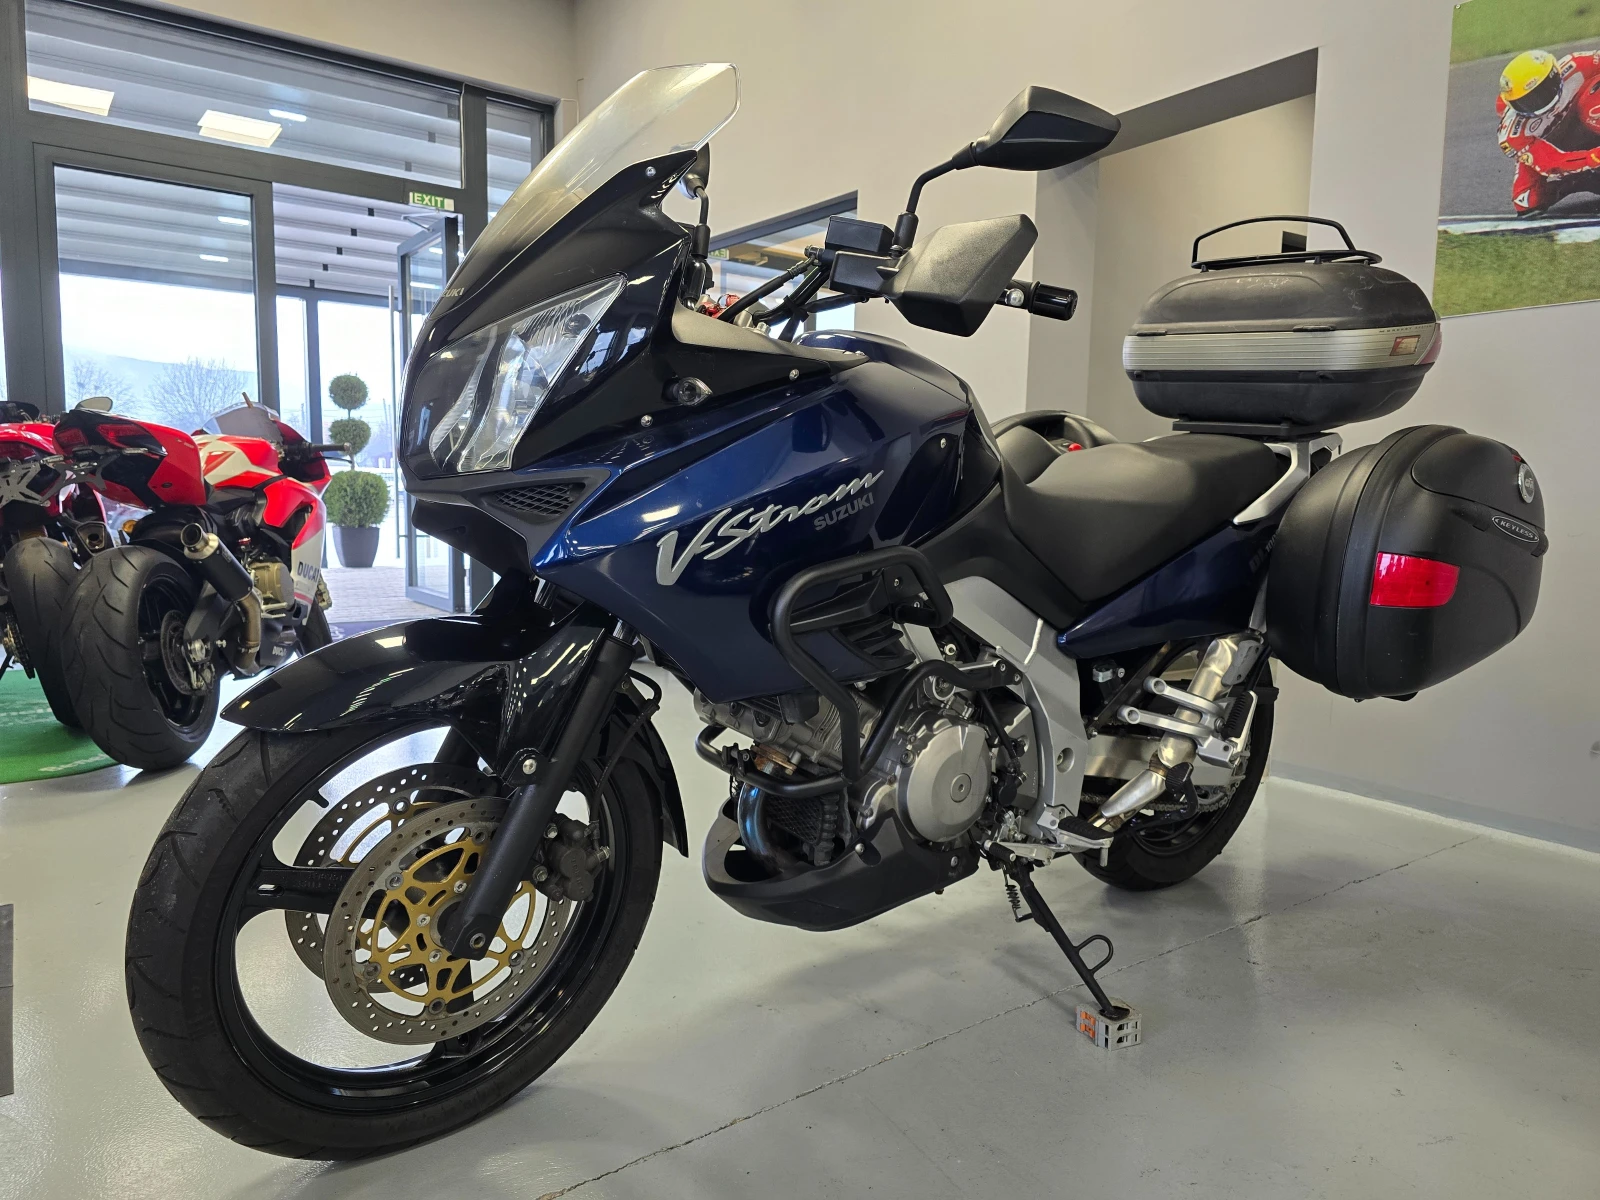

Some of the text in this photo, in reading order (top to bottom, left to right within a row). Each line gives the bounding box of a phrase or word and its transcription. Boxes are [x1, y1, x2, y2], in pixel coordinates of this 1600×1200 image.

[414, 192, 444, 208] EXIT
[813, 491, 874, 531] SUZUKI
[1500, 520, 1534, 539] KEYLESS
